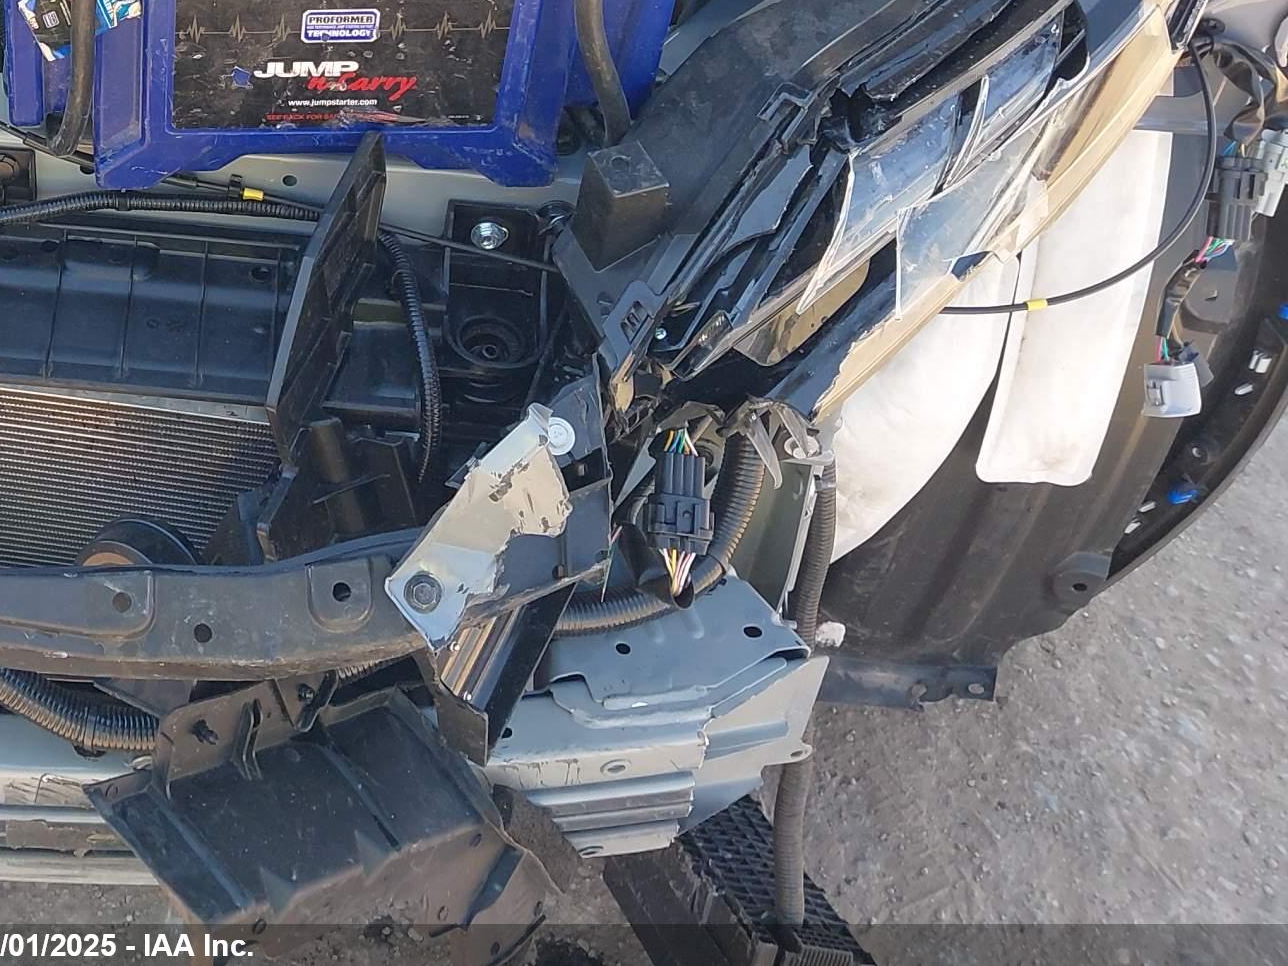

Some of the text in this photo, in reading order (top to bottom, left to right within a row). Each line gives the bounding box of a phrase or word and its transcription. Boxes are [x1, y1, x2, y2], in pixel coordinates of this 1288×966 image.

[309, 16, 373, 24] PROFORMER
[253, 61, 359, 78] JUMP
[287, 97, 378, 107] www.jumpstarter.com
